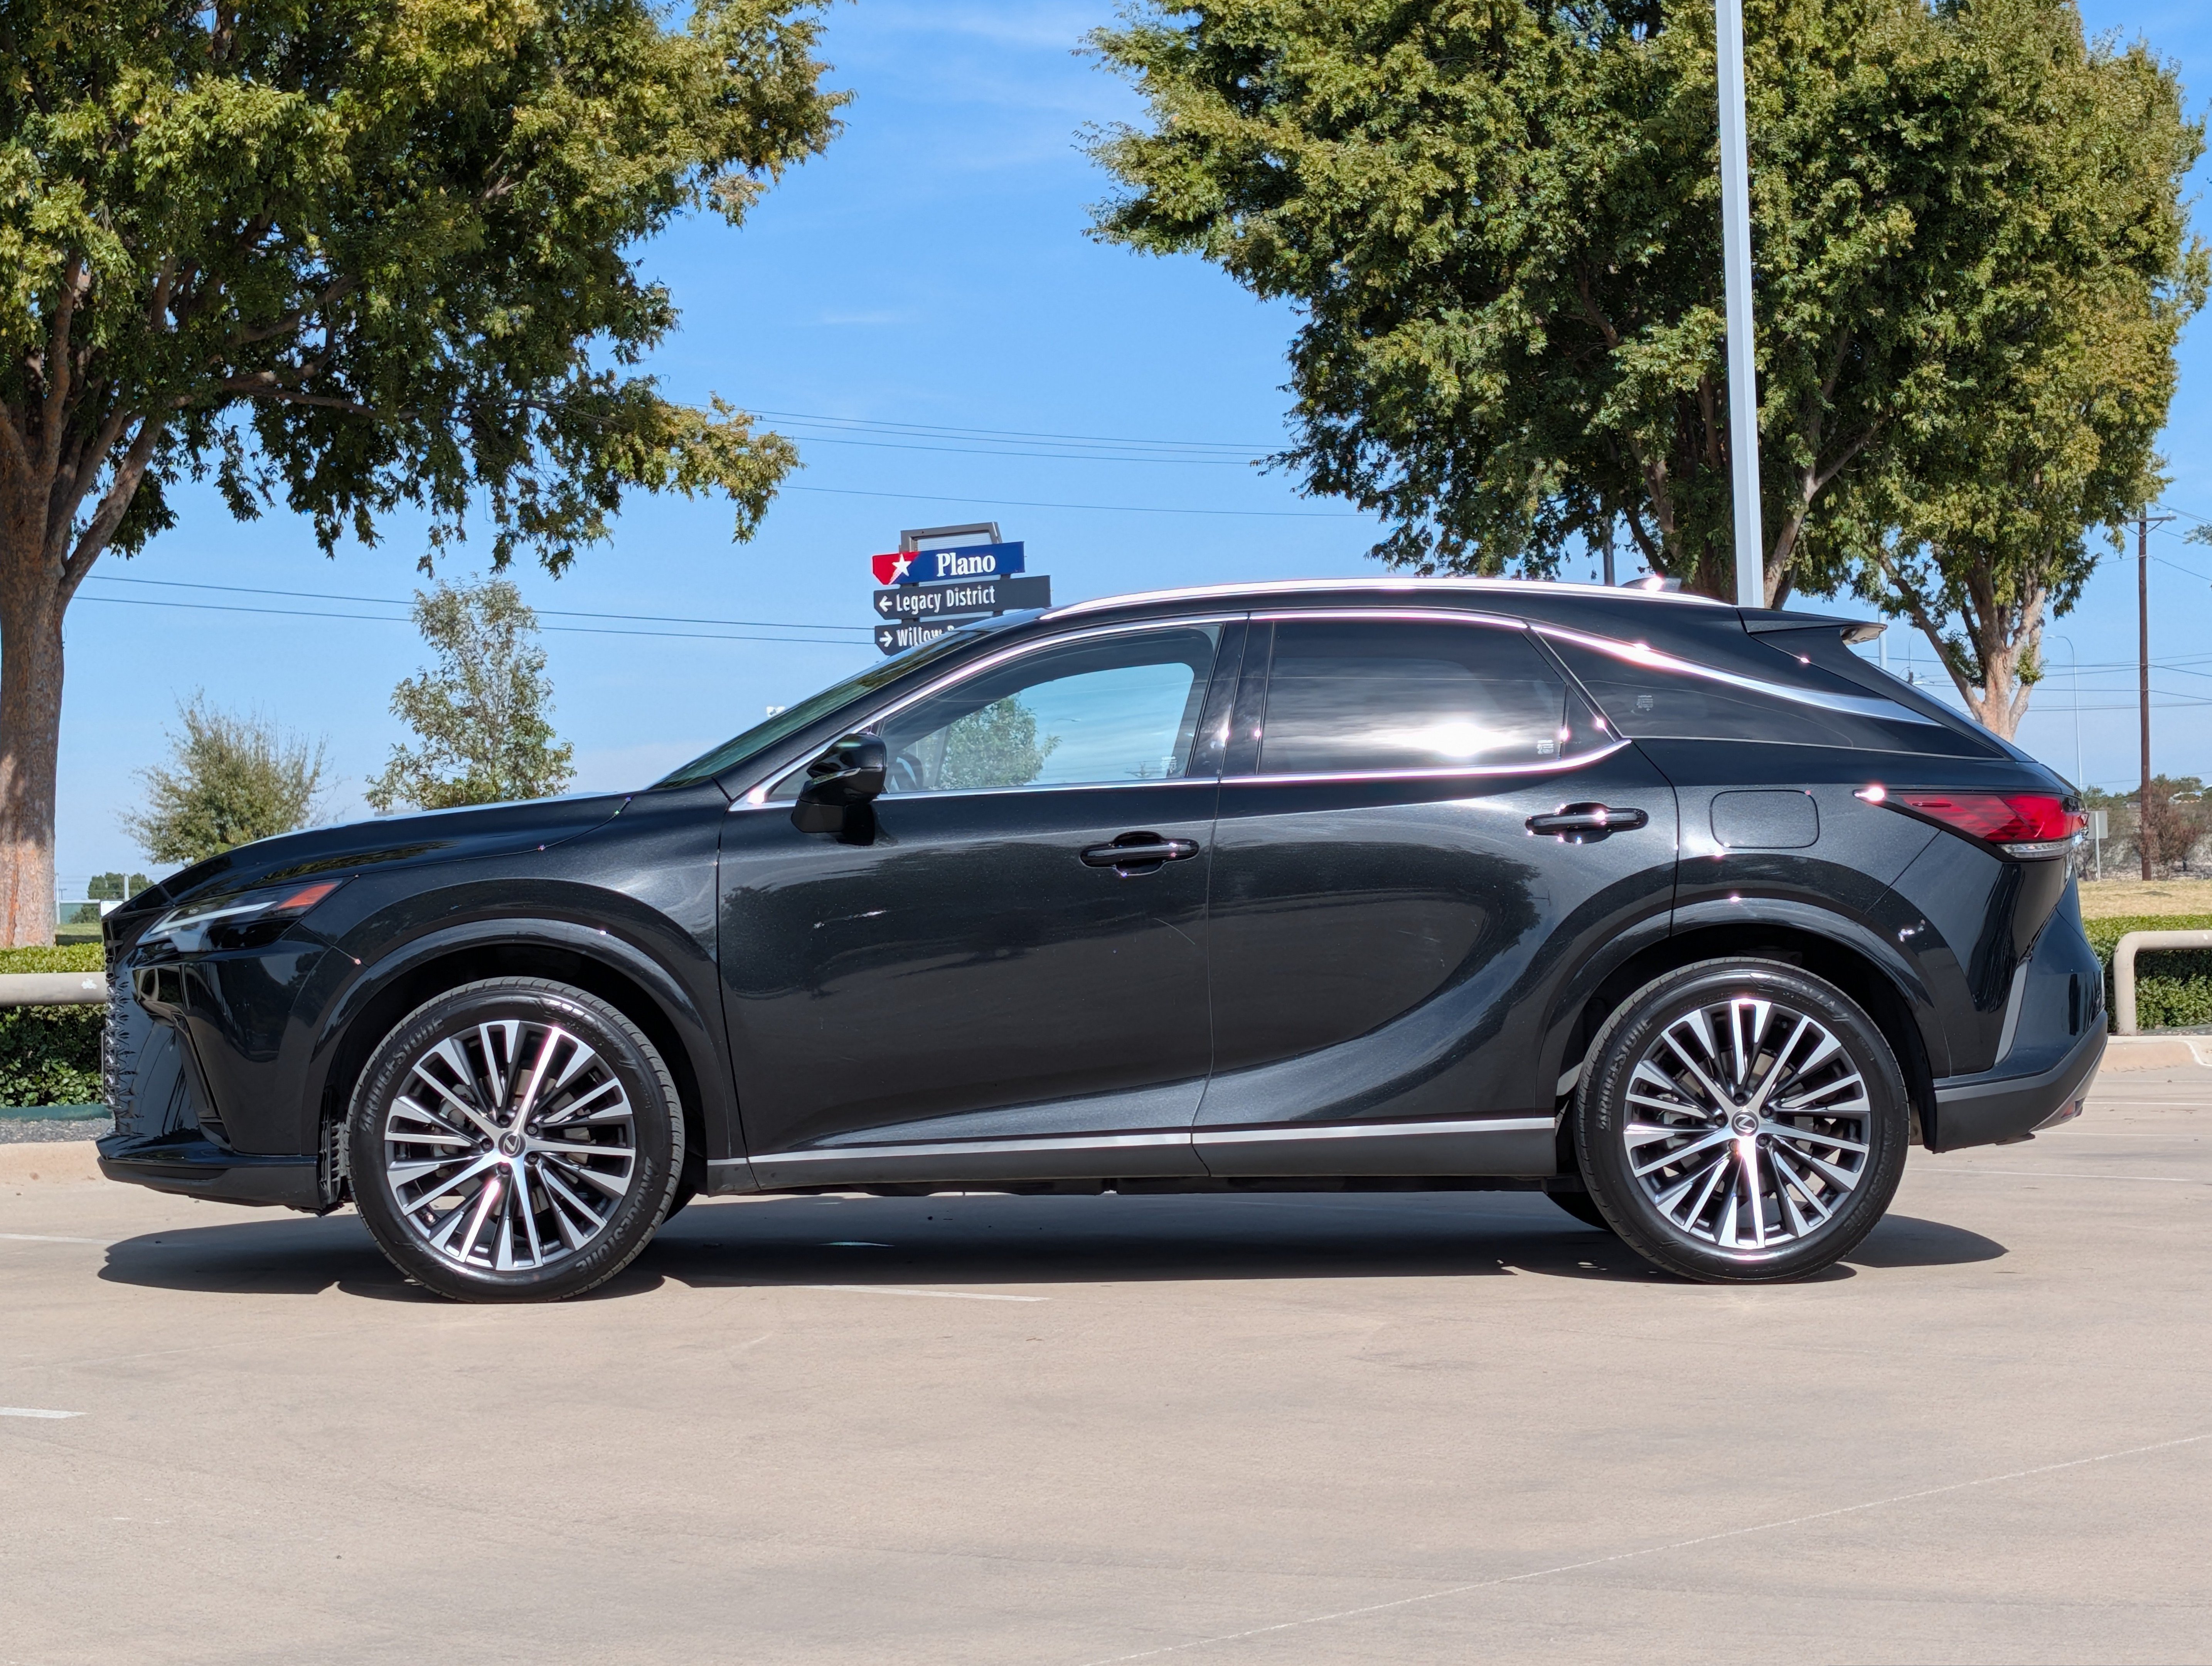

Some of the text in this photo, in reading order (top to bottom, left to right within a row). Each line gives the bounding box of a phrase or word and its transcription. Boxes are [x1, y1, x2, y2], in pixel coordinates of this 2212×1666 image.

[896, 585, 996, 615] Legacy District
[936, 552, 996, 577] Plano
[358, 1017, 443, 1135] BRIDGESTONE
[1596, 1018, 1653, 1131] BRIDGESTONE
